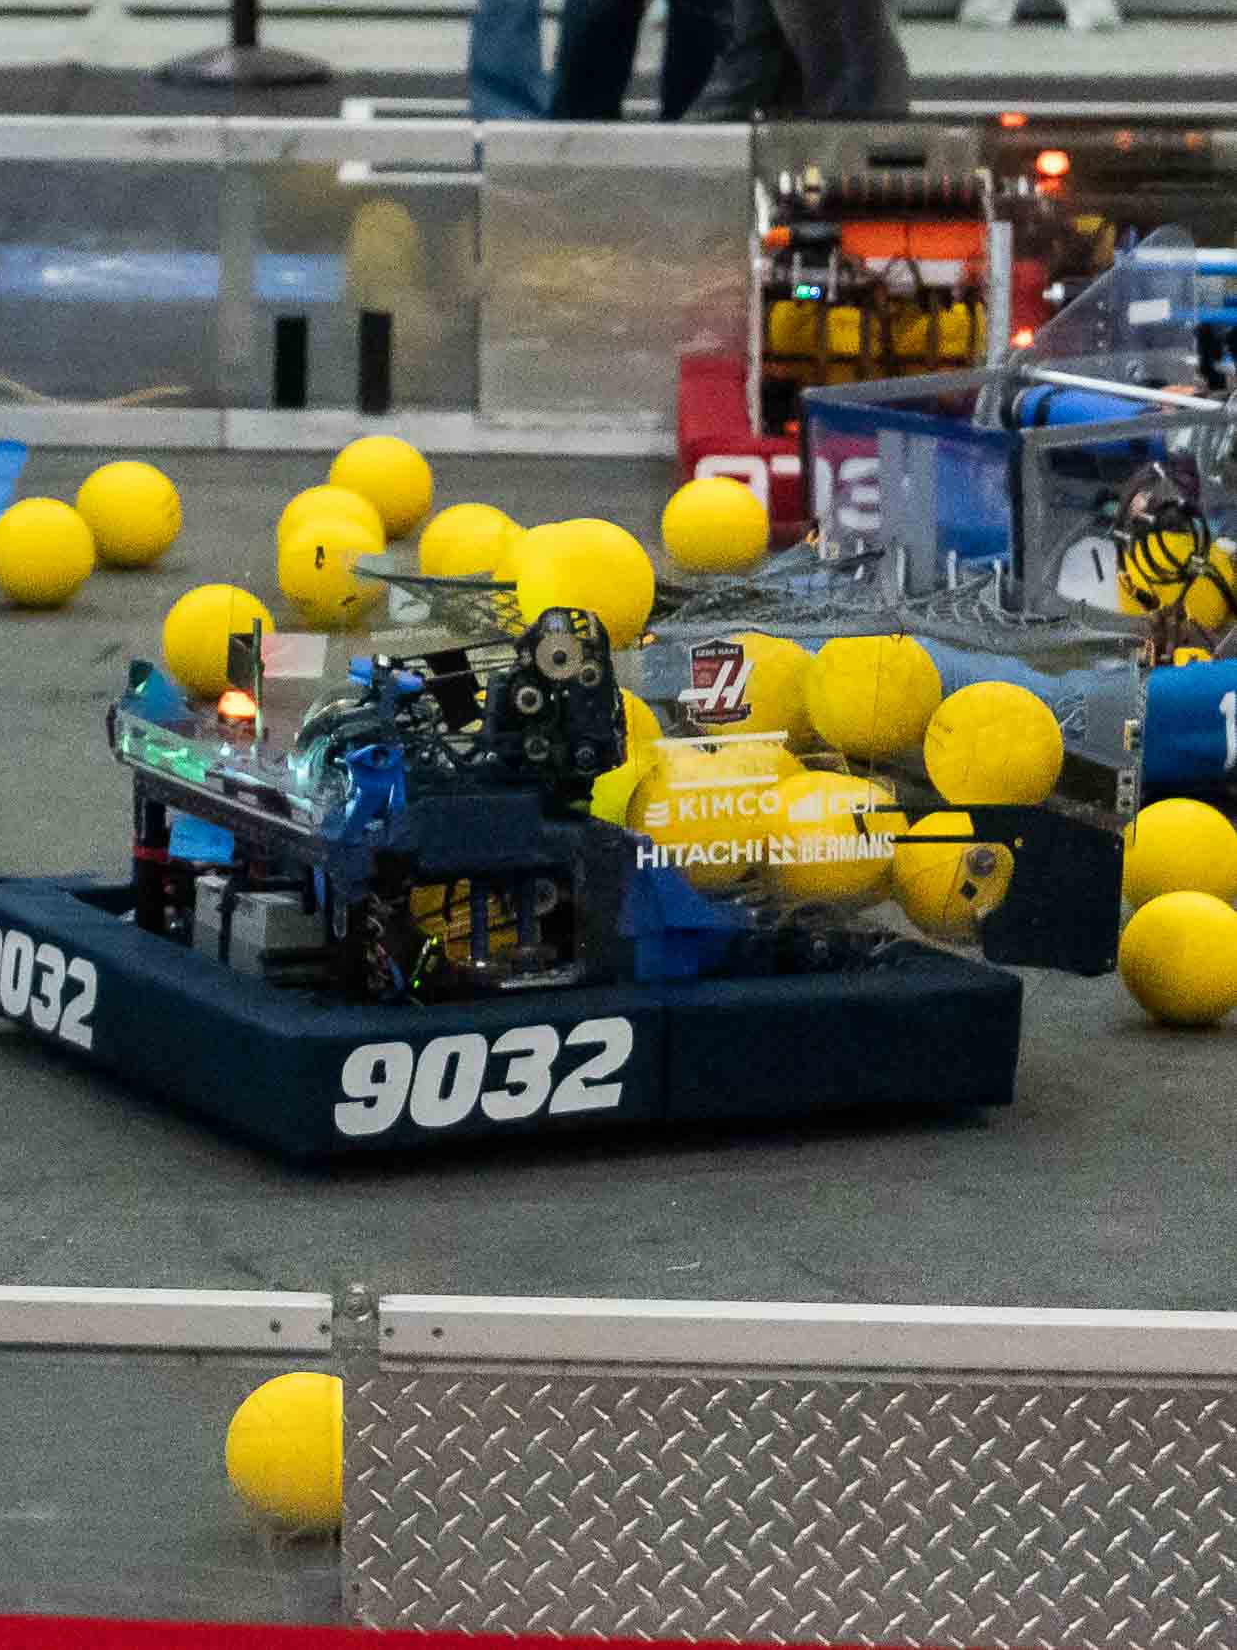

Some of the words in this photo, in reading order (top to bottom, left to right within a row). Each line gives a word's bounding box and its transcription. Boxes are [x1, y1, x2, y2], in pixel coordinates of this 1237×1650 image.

[677, 789, 780, 823] KIMCO
[636, 838, 763, 869] HITACHI
[334, 1016, 634, 1137] 9032
